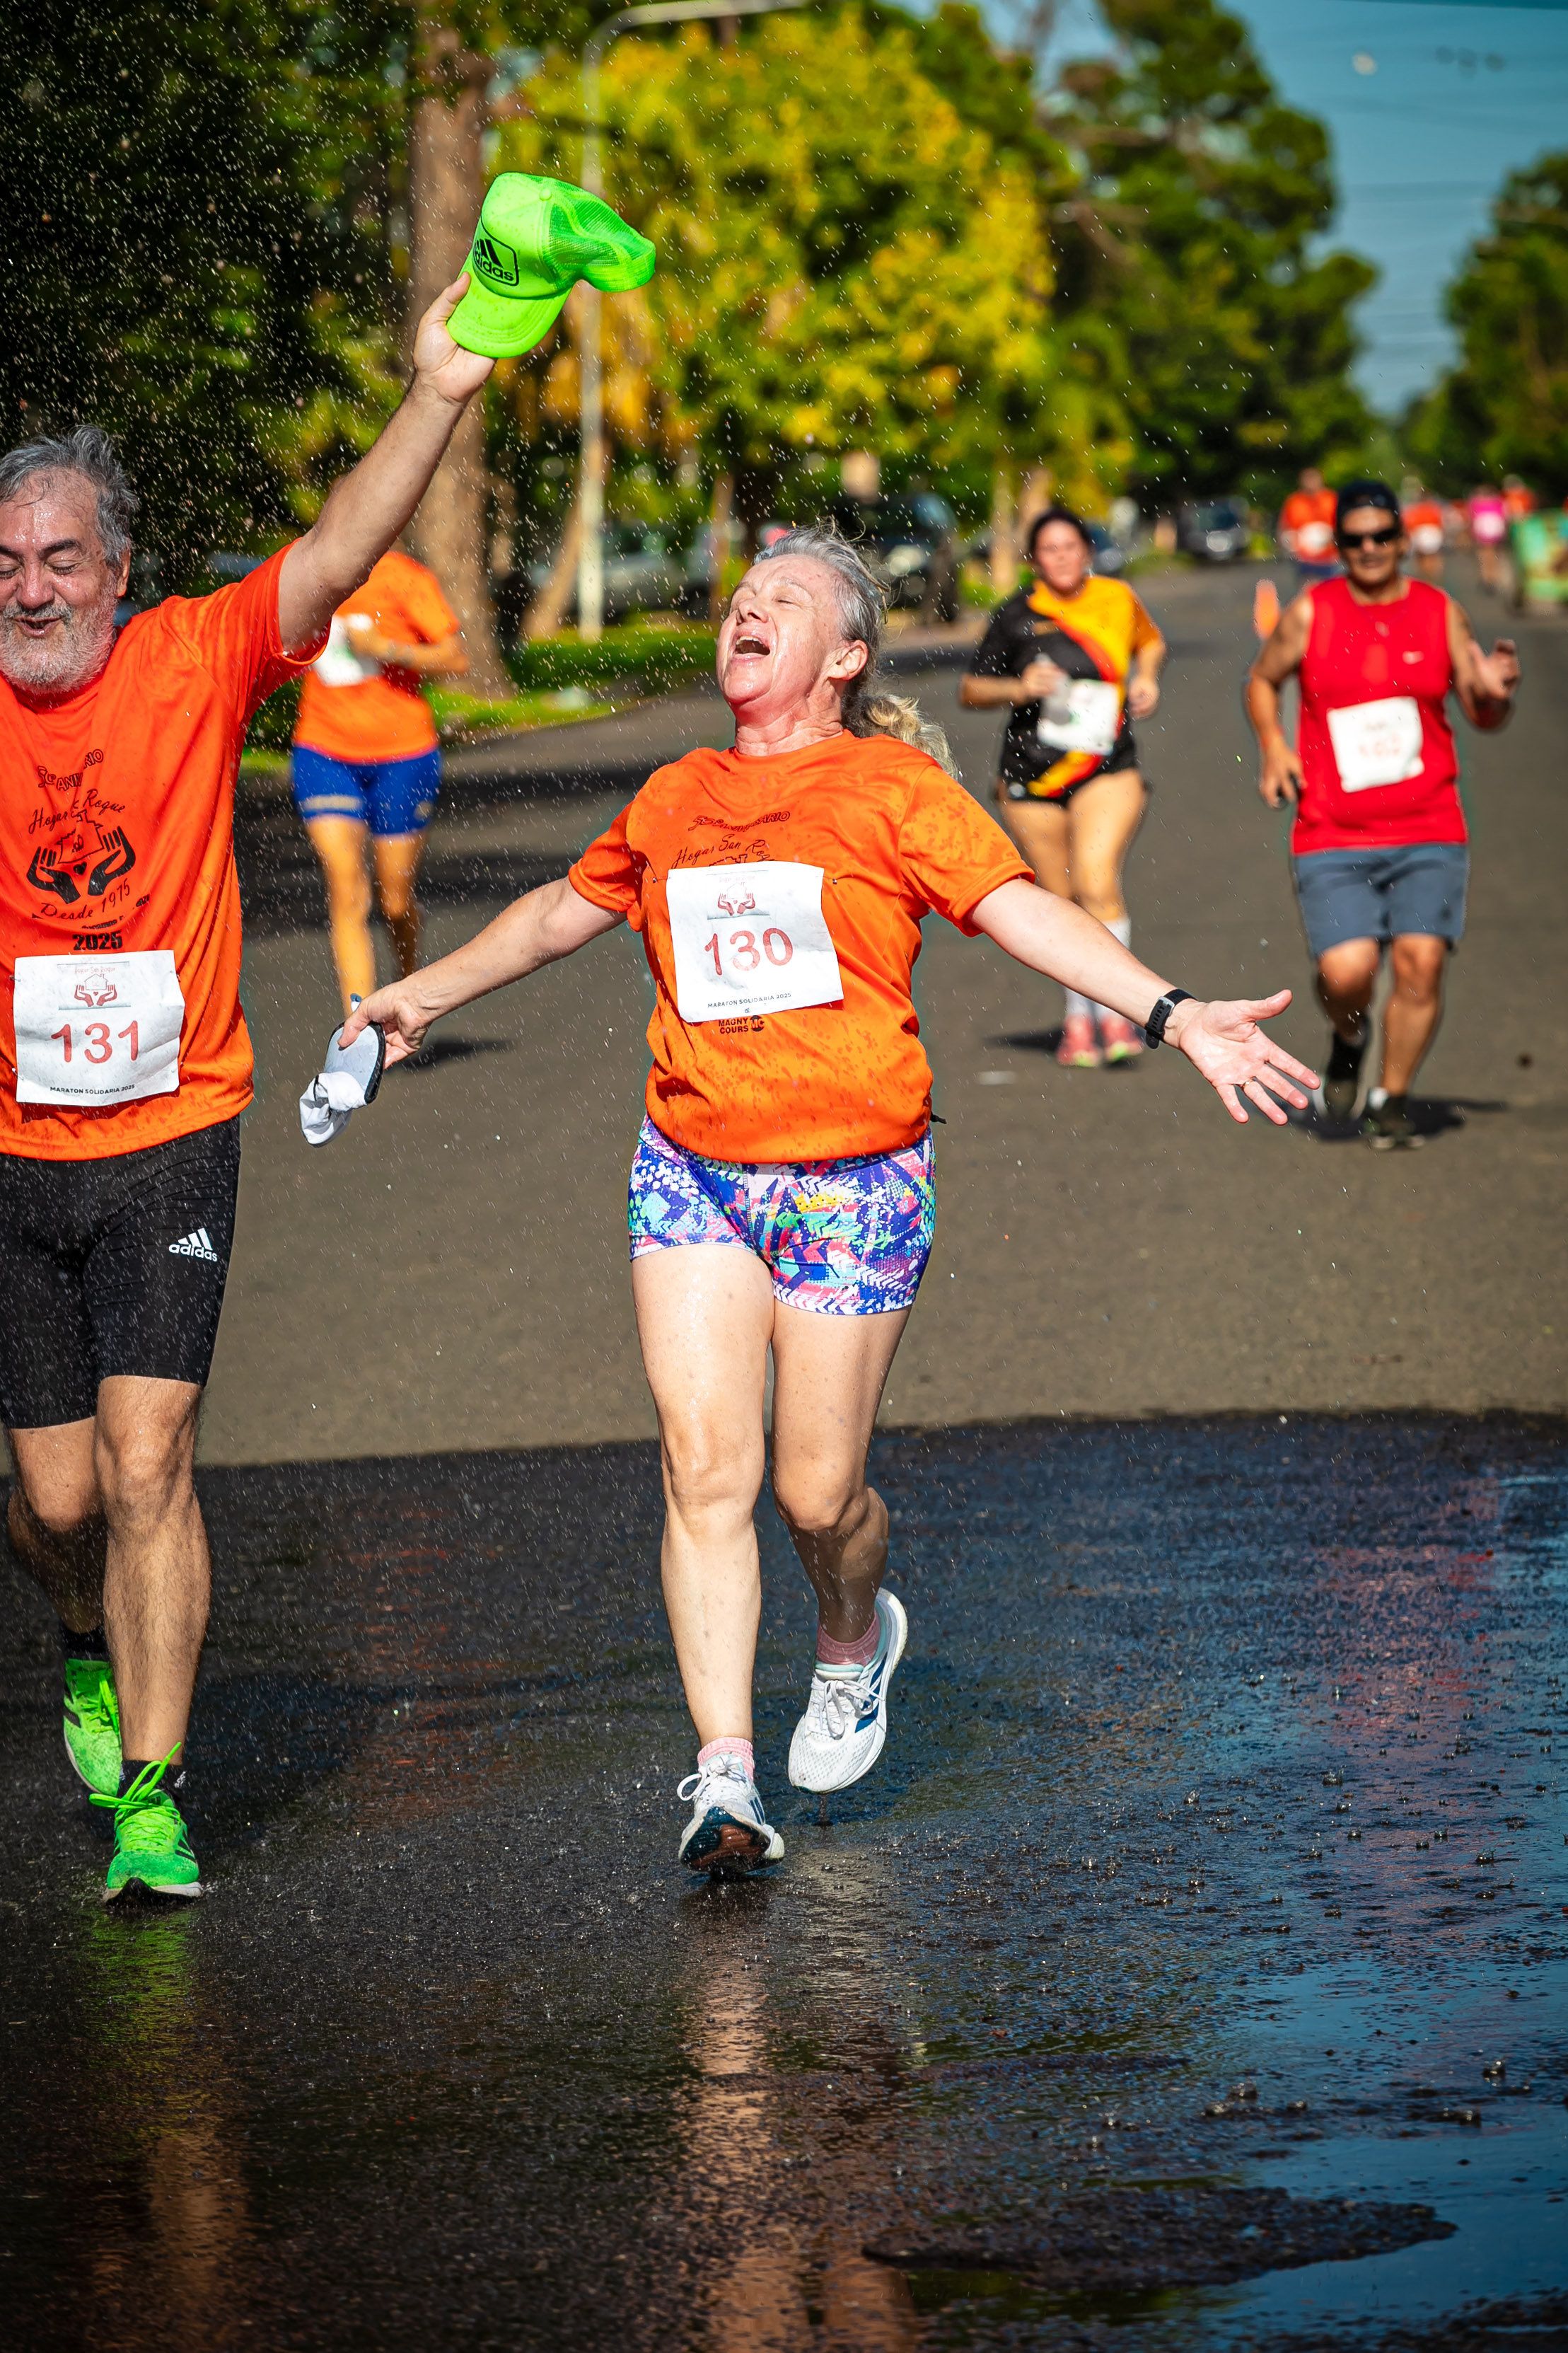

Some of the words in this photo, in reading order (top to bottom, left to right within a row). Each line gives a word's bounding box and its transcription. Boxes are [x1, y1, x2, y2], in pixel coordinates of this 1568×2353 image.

[28, 807, 68, 834] Hogar
[83, 788, 126, 816] Roque
[671, 846, 714, 869] Hogar
[719, 833, 741, 851] San
[41, 902, 93, 919] Desde
[102, 878, 130, 913] 1975
[72, 930, 123, 950] 2025
[704, 927, 794, 976] 130
[707, 1000, 738, 1008] MARATON
[739, 995, 774, 1005] SOLIDARIA
[719, 1017, 748, 1027] MAGNY
[719, 1025, 749, 1034] COURS
[50, 1020, 139, 1063] 131
[168, 1244, 218, 1262] adidas
